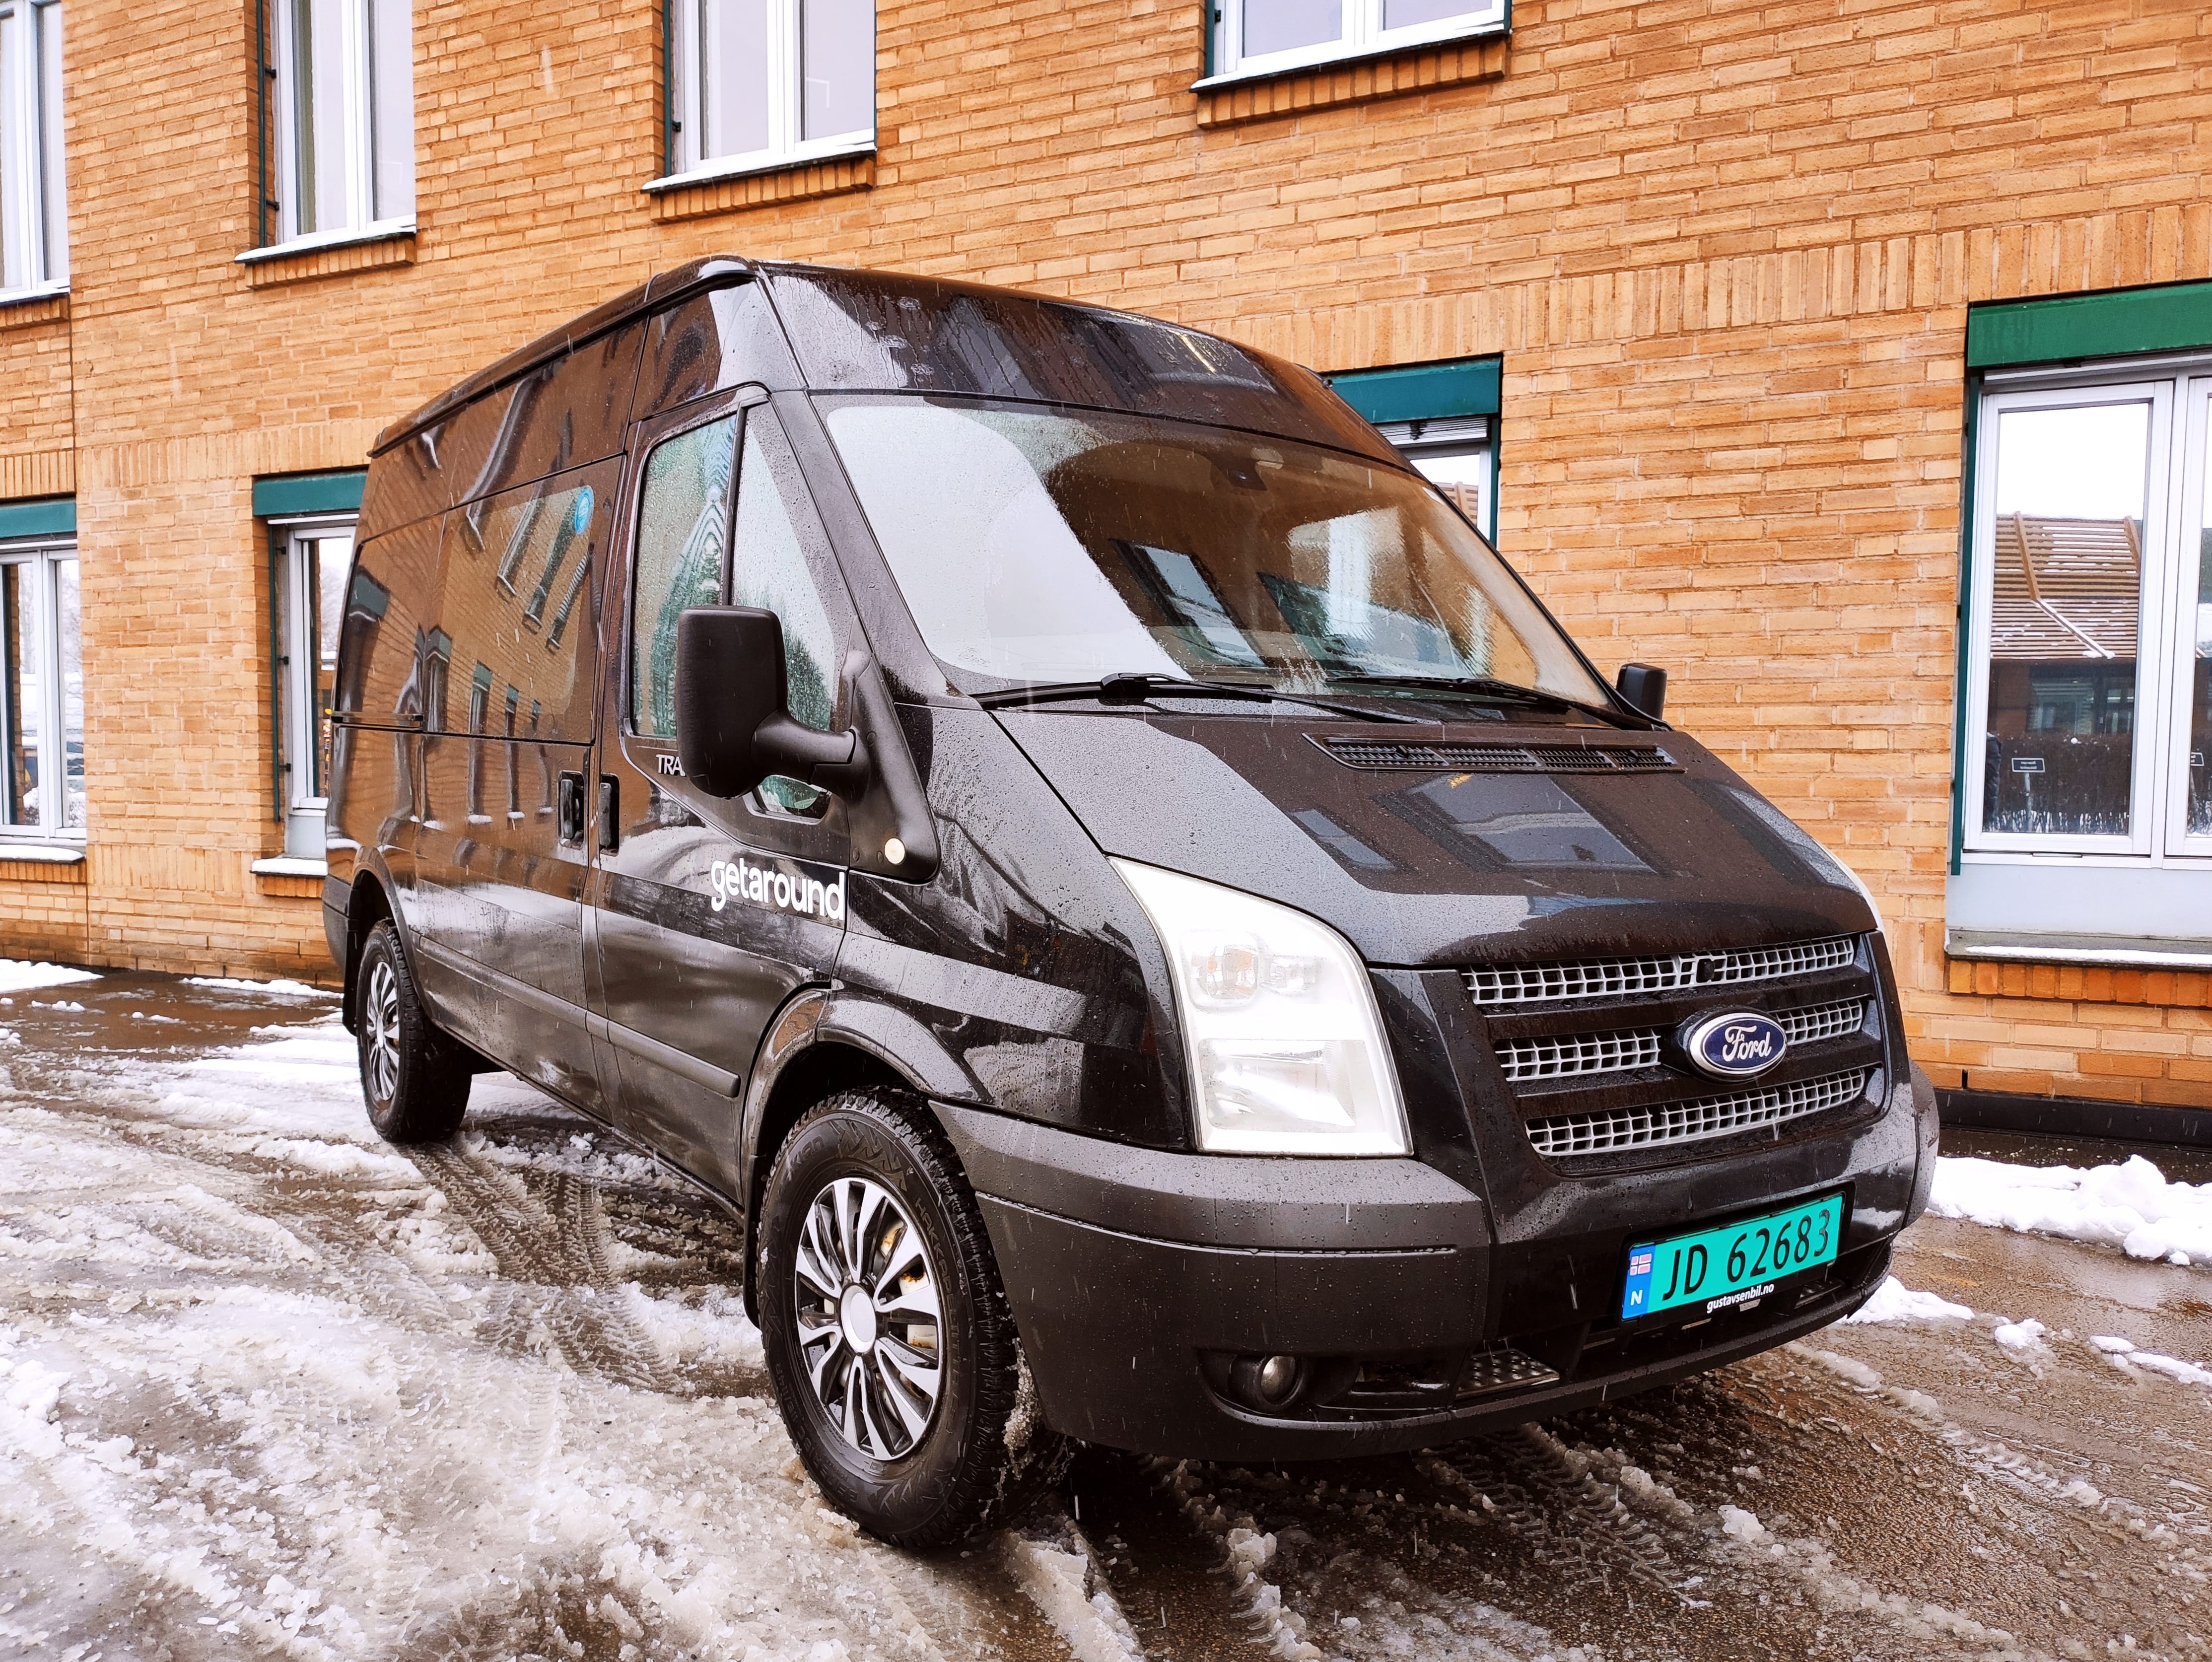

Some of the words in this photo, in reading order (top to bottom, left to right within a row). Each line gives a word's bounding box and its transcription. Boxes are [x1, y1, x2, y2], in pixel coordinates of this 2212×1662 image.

[656, 754, 686, 776] TRA
[711, 858, 845, 921] getaround
[1722, 1025, 1772, 1062] Ford
[1662, 1245, 1708, 1302] JD
[1727, 1209, 1830, 1283] 62683
[1630, 1290, 1643, 1306] N
[1707, 1284, 1775, 1314] gustavsenbil.no
